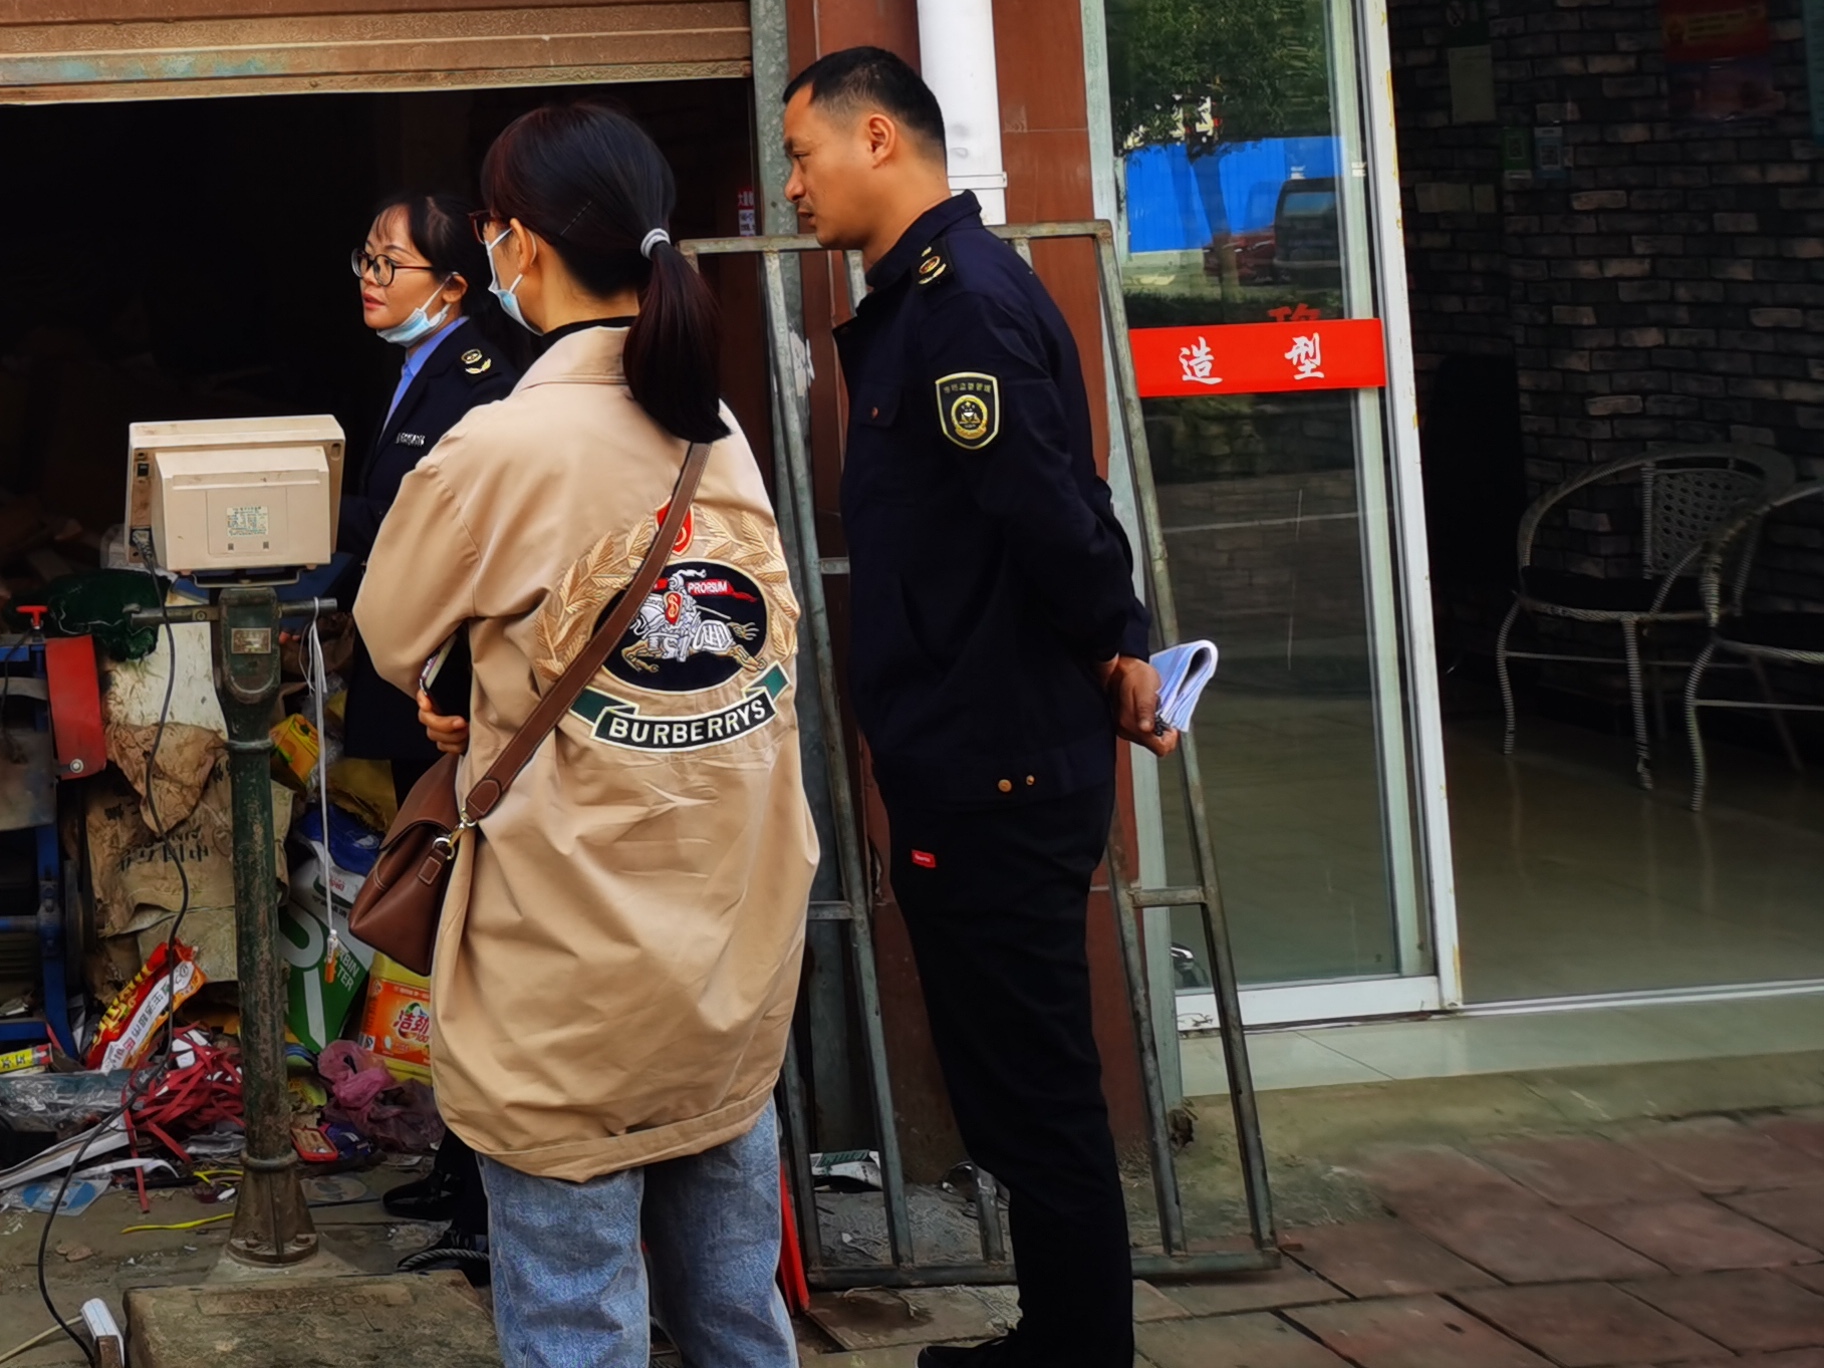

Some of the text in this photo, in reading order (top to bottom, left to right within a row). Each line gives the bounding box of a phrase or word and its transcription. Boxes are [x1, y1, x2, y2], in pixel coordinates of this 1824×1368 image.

[1178, 332, 1325, 385] 造型
[687, 579, 729, 594] PRORSUM
[608, 699, 767, 745] BURBERRYS
